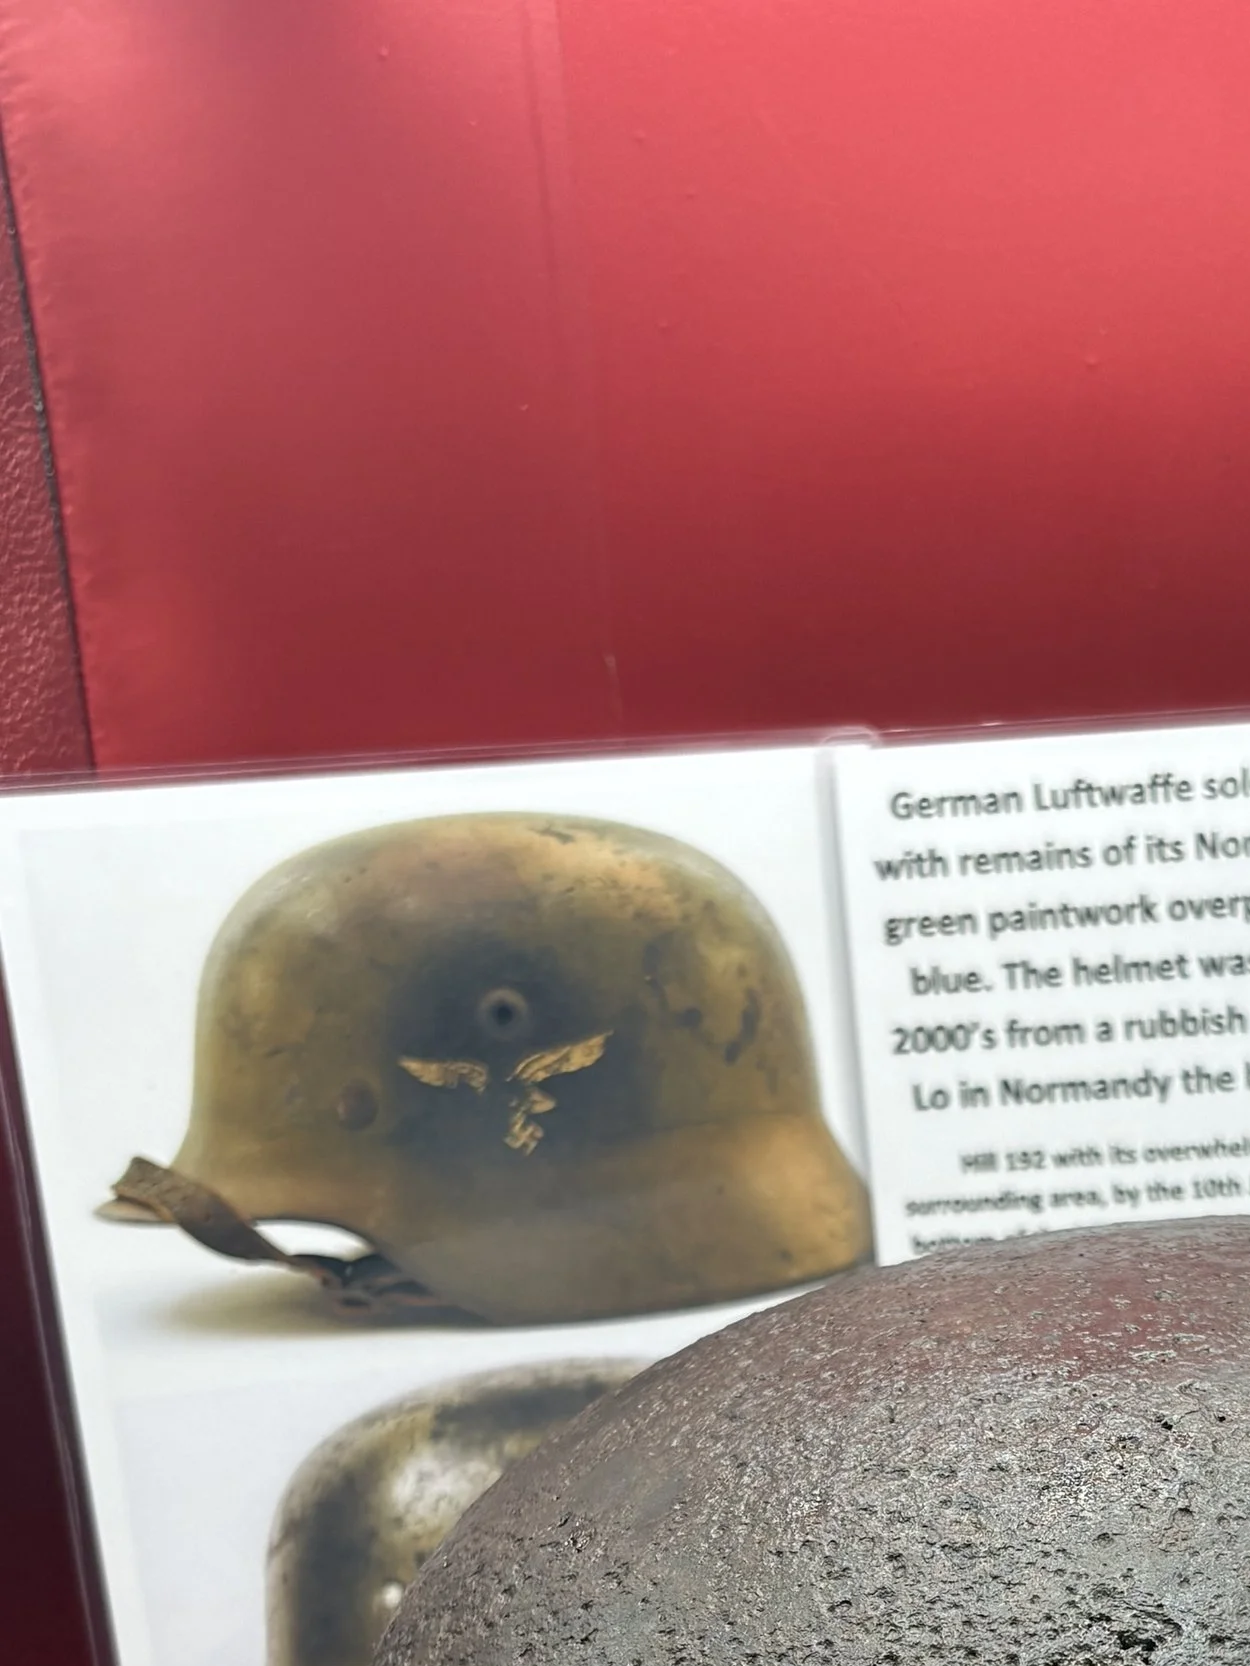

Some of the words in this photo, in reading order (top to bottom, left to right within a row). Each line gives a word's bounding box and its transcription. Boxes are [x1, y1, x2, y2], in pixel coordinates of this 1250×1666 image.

[891, 785, 1023, 821] German
[1035, 772, 1193, 813] Luftwaffe
[876, 848, 948, 881] with
[959, 840, 1092, 874] remains
[1104, 836, 1137, 866] of
[1146, 834, 1183, 864] its
[884, 907, 978, 944] green
[989, 895, 1157, 940] paintwork
[911, 966, 993, 995] blue.
[1004, 961, 1063, 990] The
[1073, 952, 1189, 986] helmet
[892, 1020, 997, 1055] 2000's
[1006, 1017, 1084, 1048] from
[1095, 1019, 1114, 1043] a
[1125, 1001, 1247, 1040] rubbish
[913, 1082, 949, 1111] Lo
[960, 1078, 990, 1108] in
[1000, 1065, 1171, 1107] Normandy
[1182, 1063, 1235, 1095] the
[961, 1152, 997, 1172] Hill
[1005, 1150, 1045, 1171] 192
[1052, 1146, 1103, 1167] with
[1109, 1144, 1137, 1164] its
[906, 1190, 1043, 1216] surrounding
[1049, 1190, 1108, 1207] area,
[1111, 1184, 1140, 1206] by
[1145, 1181, 1183, 1200] the
[1191, 1176, 1241, 1198] 10th
